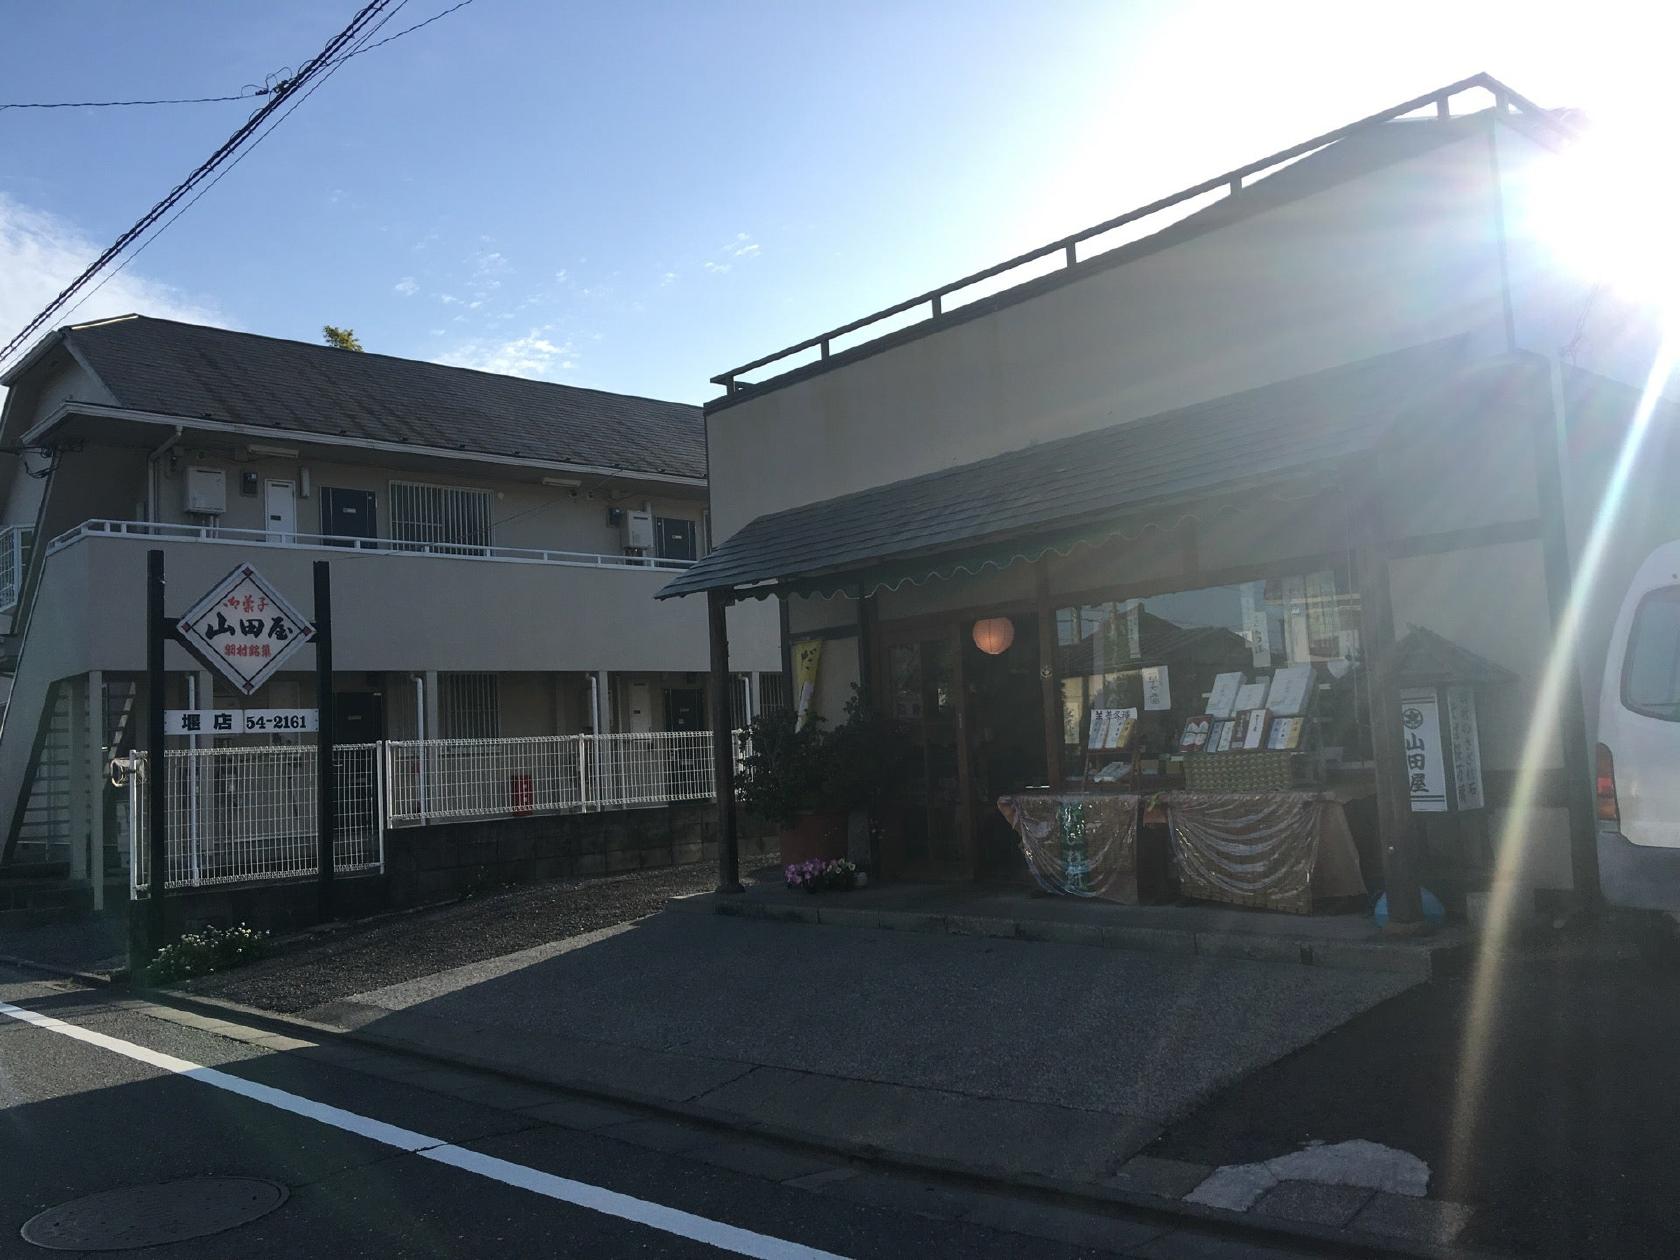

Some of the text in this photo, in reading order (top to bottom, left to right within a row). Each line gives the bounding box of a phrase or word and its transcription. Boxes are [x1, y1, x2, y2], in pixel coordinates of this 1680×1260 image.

[223, 594, 270, 613] 御菓子
[205, 611, 293, 641] 山田屋
[223, 643, 272, 658] 羽村銘菓
[246, 715, 307, 730] 54-2161
[1405, 733, 1430, 793] 山田屋
